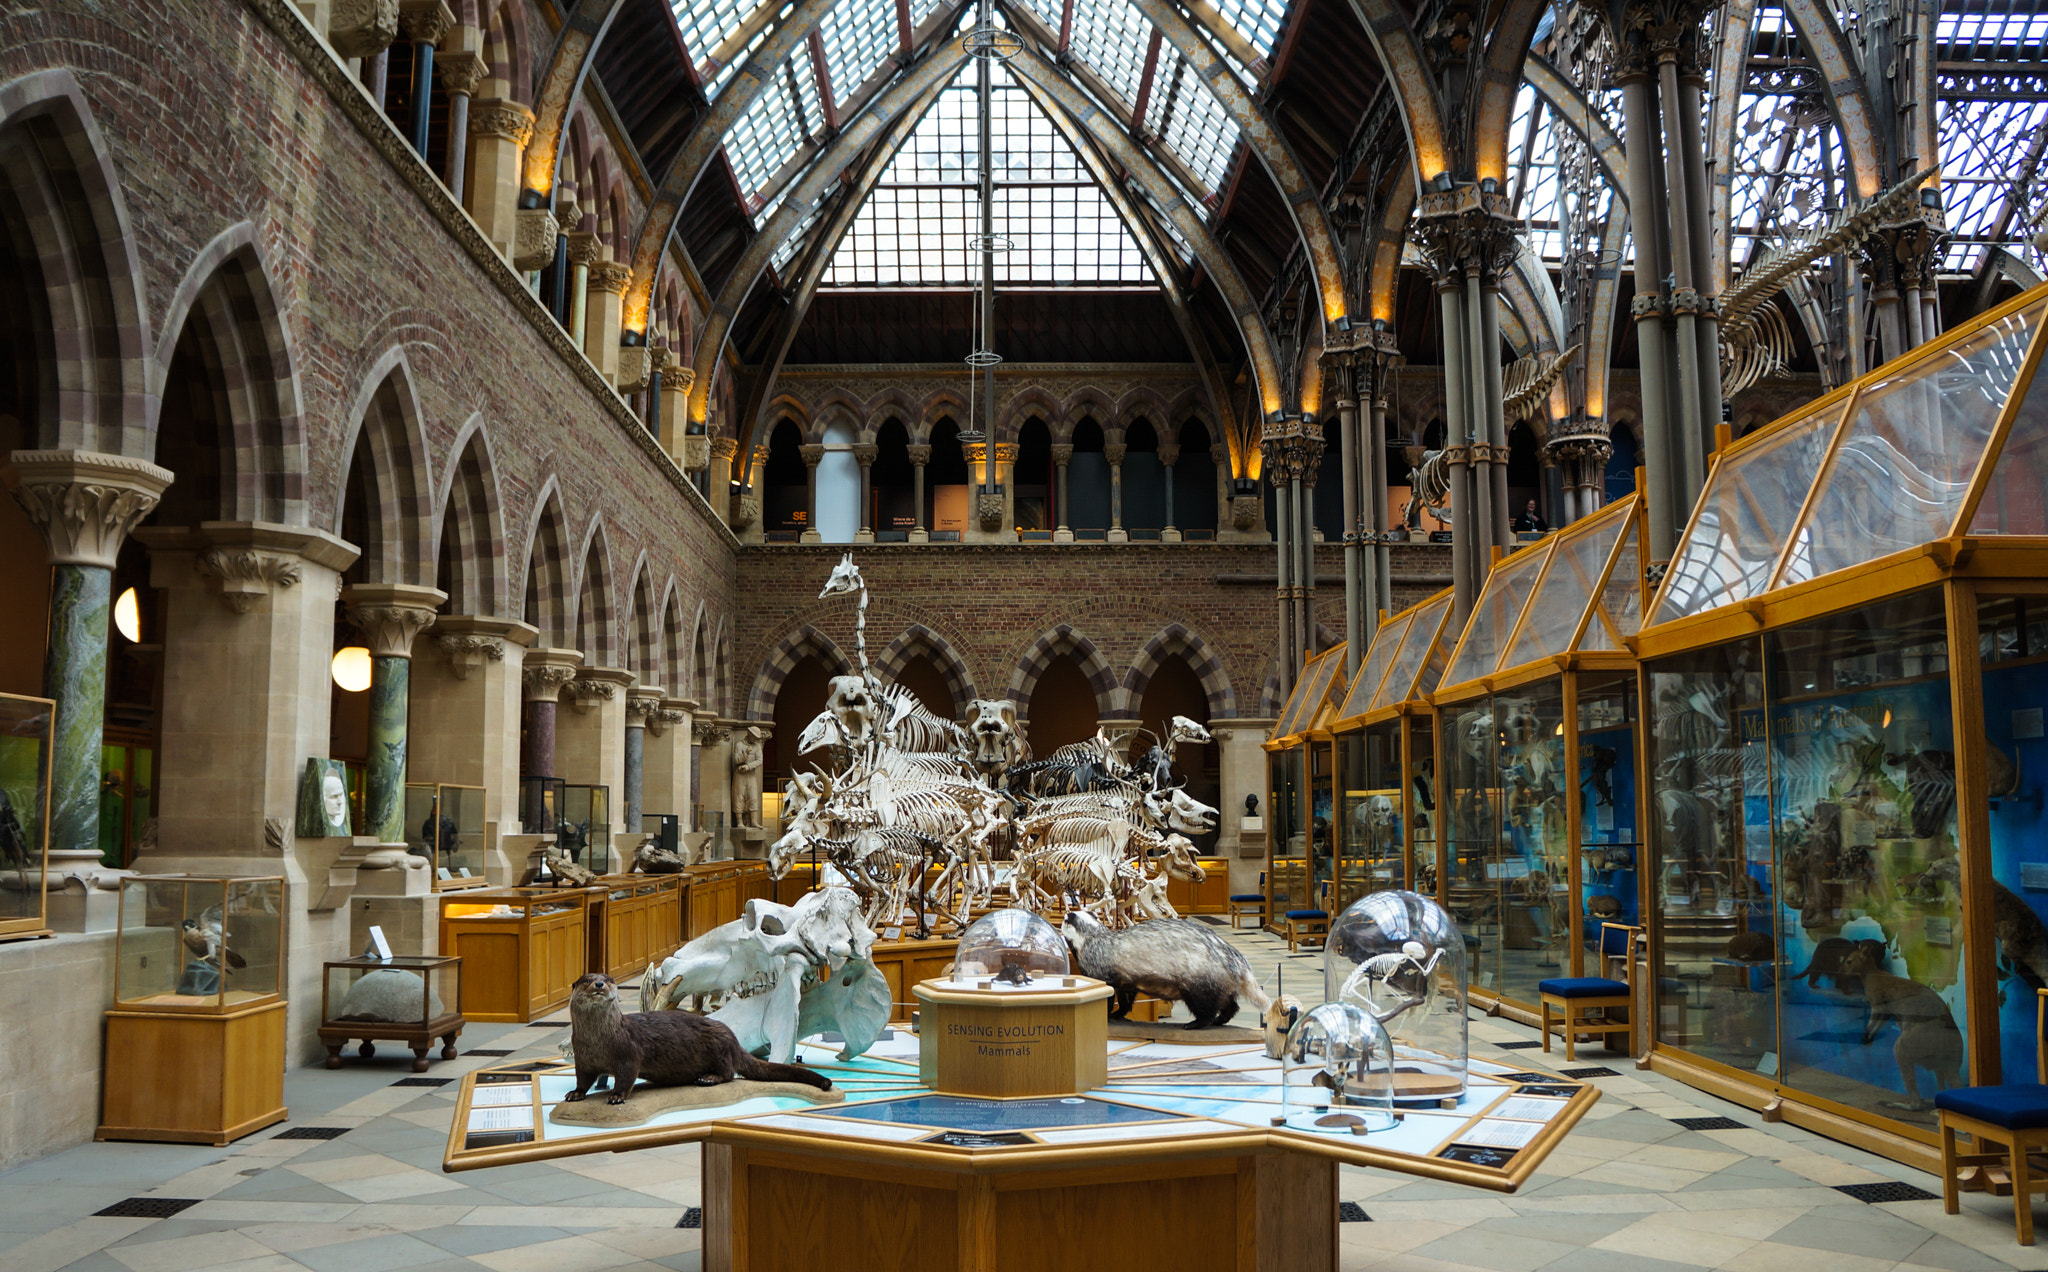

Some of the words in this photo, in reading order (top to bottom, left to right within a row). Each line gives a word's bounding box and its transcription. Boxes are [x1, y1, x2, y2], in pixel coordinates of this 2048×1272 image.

[1809, 705, 1824, 731] of
[947, 1024, 993, 1037] SENSING
[997, 1025, 1064, 1038] EVOLUTION
[978, 1045, 1031, 1057] Mammals
